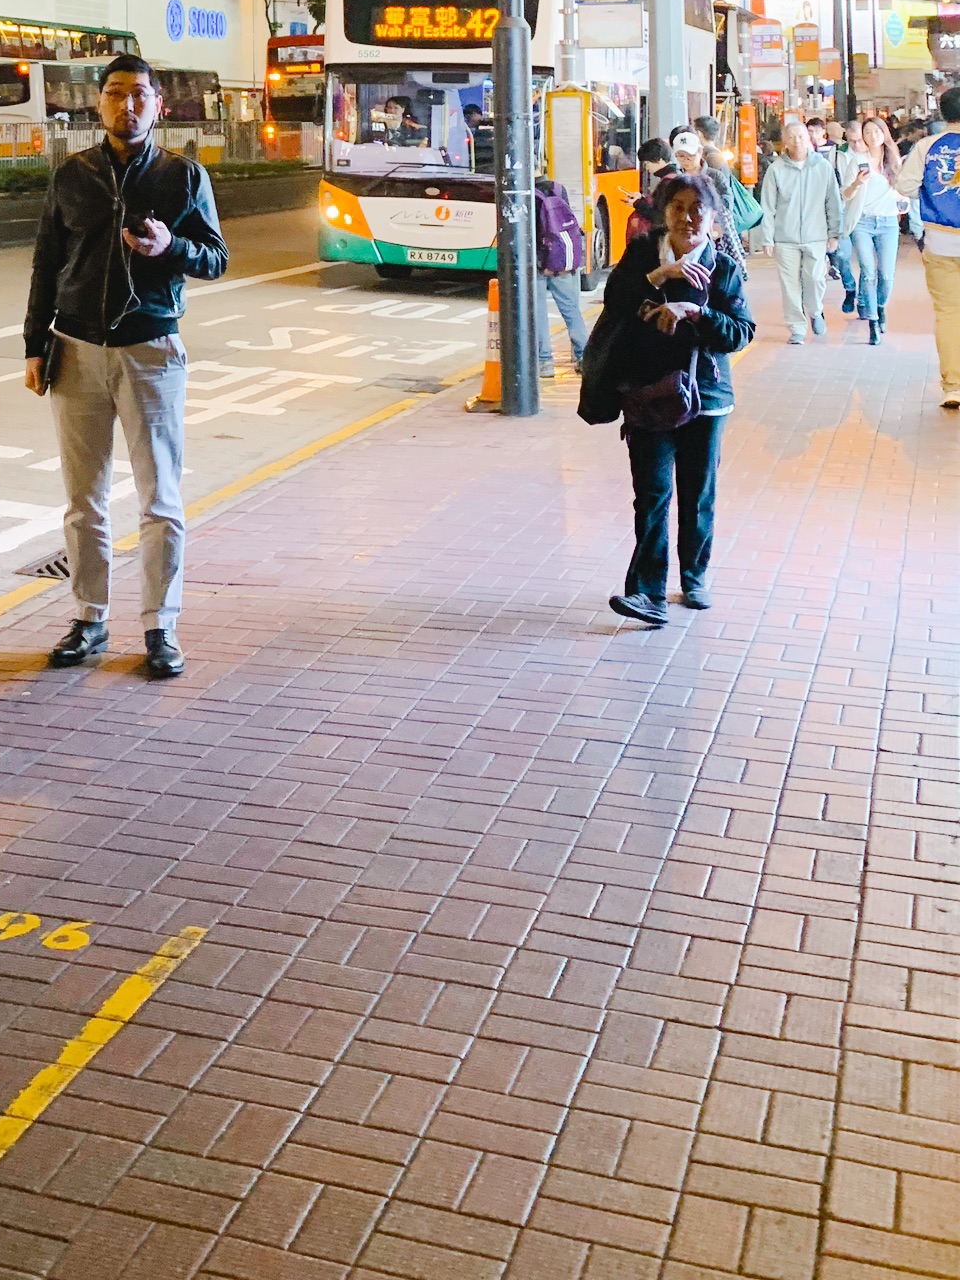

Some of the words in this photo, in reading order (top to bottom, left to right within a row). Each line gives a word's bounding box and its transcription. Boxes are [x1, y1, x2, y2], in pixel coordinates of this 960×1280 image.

[188, 6, 227, 40] SOGO
[384, 6, 458, 26] 華富邨
[374, 24, 402, 38] Wah
[404, 24, 421, 38] Fu
[423, 24, 468, 38] Estate
[357, 49, 381, 59] 5562
[409, 250, 424, 261] RX
[426, 252, 456, 263] 8749
